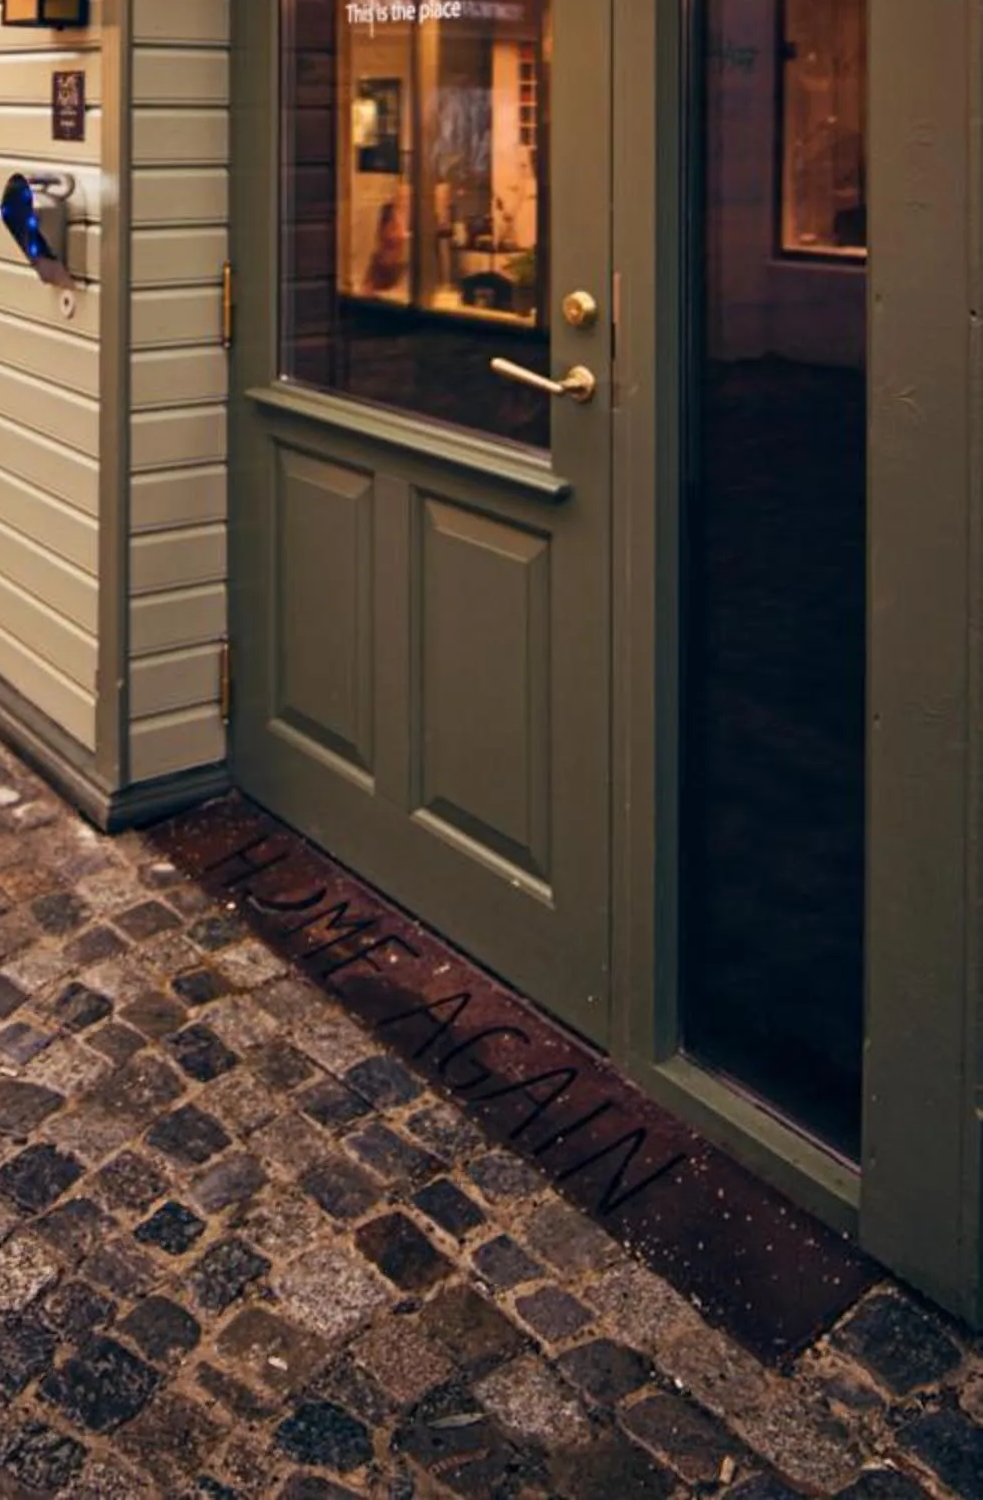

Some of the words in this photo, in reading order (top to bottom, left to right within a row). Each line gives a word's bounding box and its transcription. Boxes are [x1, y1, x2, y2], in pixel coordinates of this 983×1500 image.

[345, 2, 374, 25] This
[375, 2, 389, 23] is
[391, 2, 415, 22] the
[377, 992, 688, 1217] AGAIN
